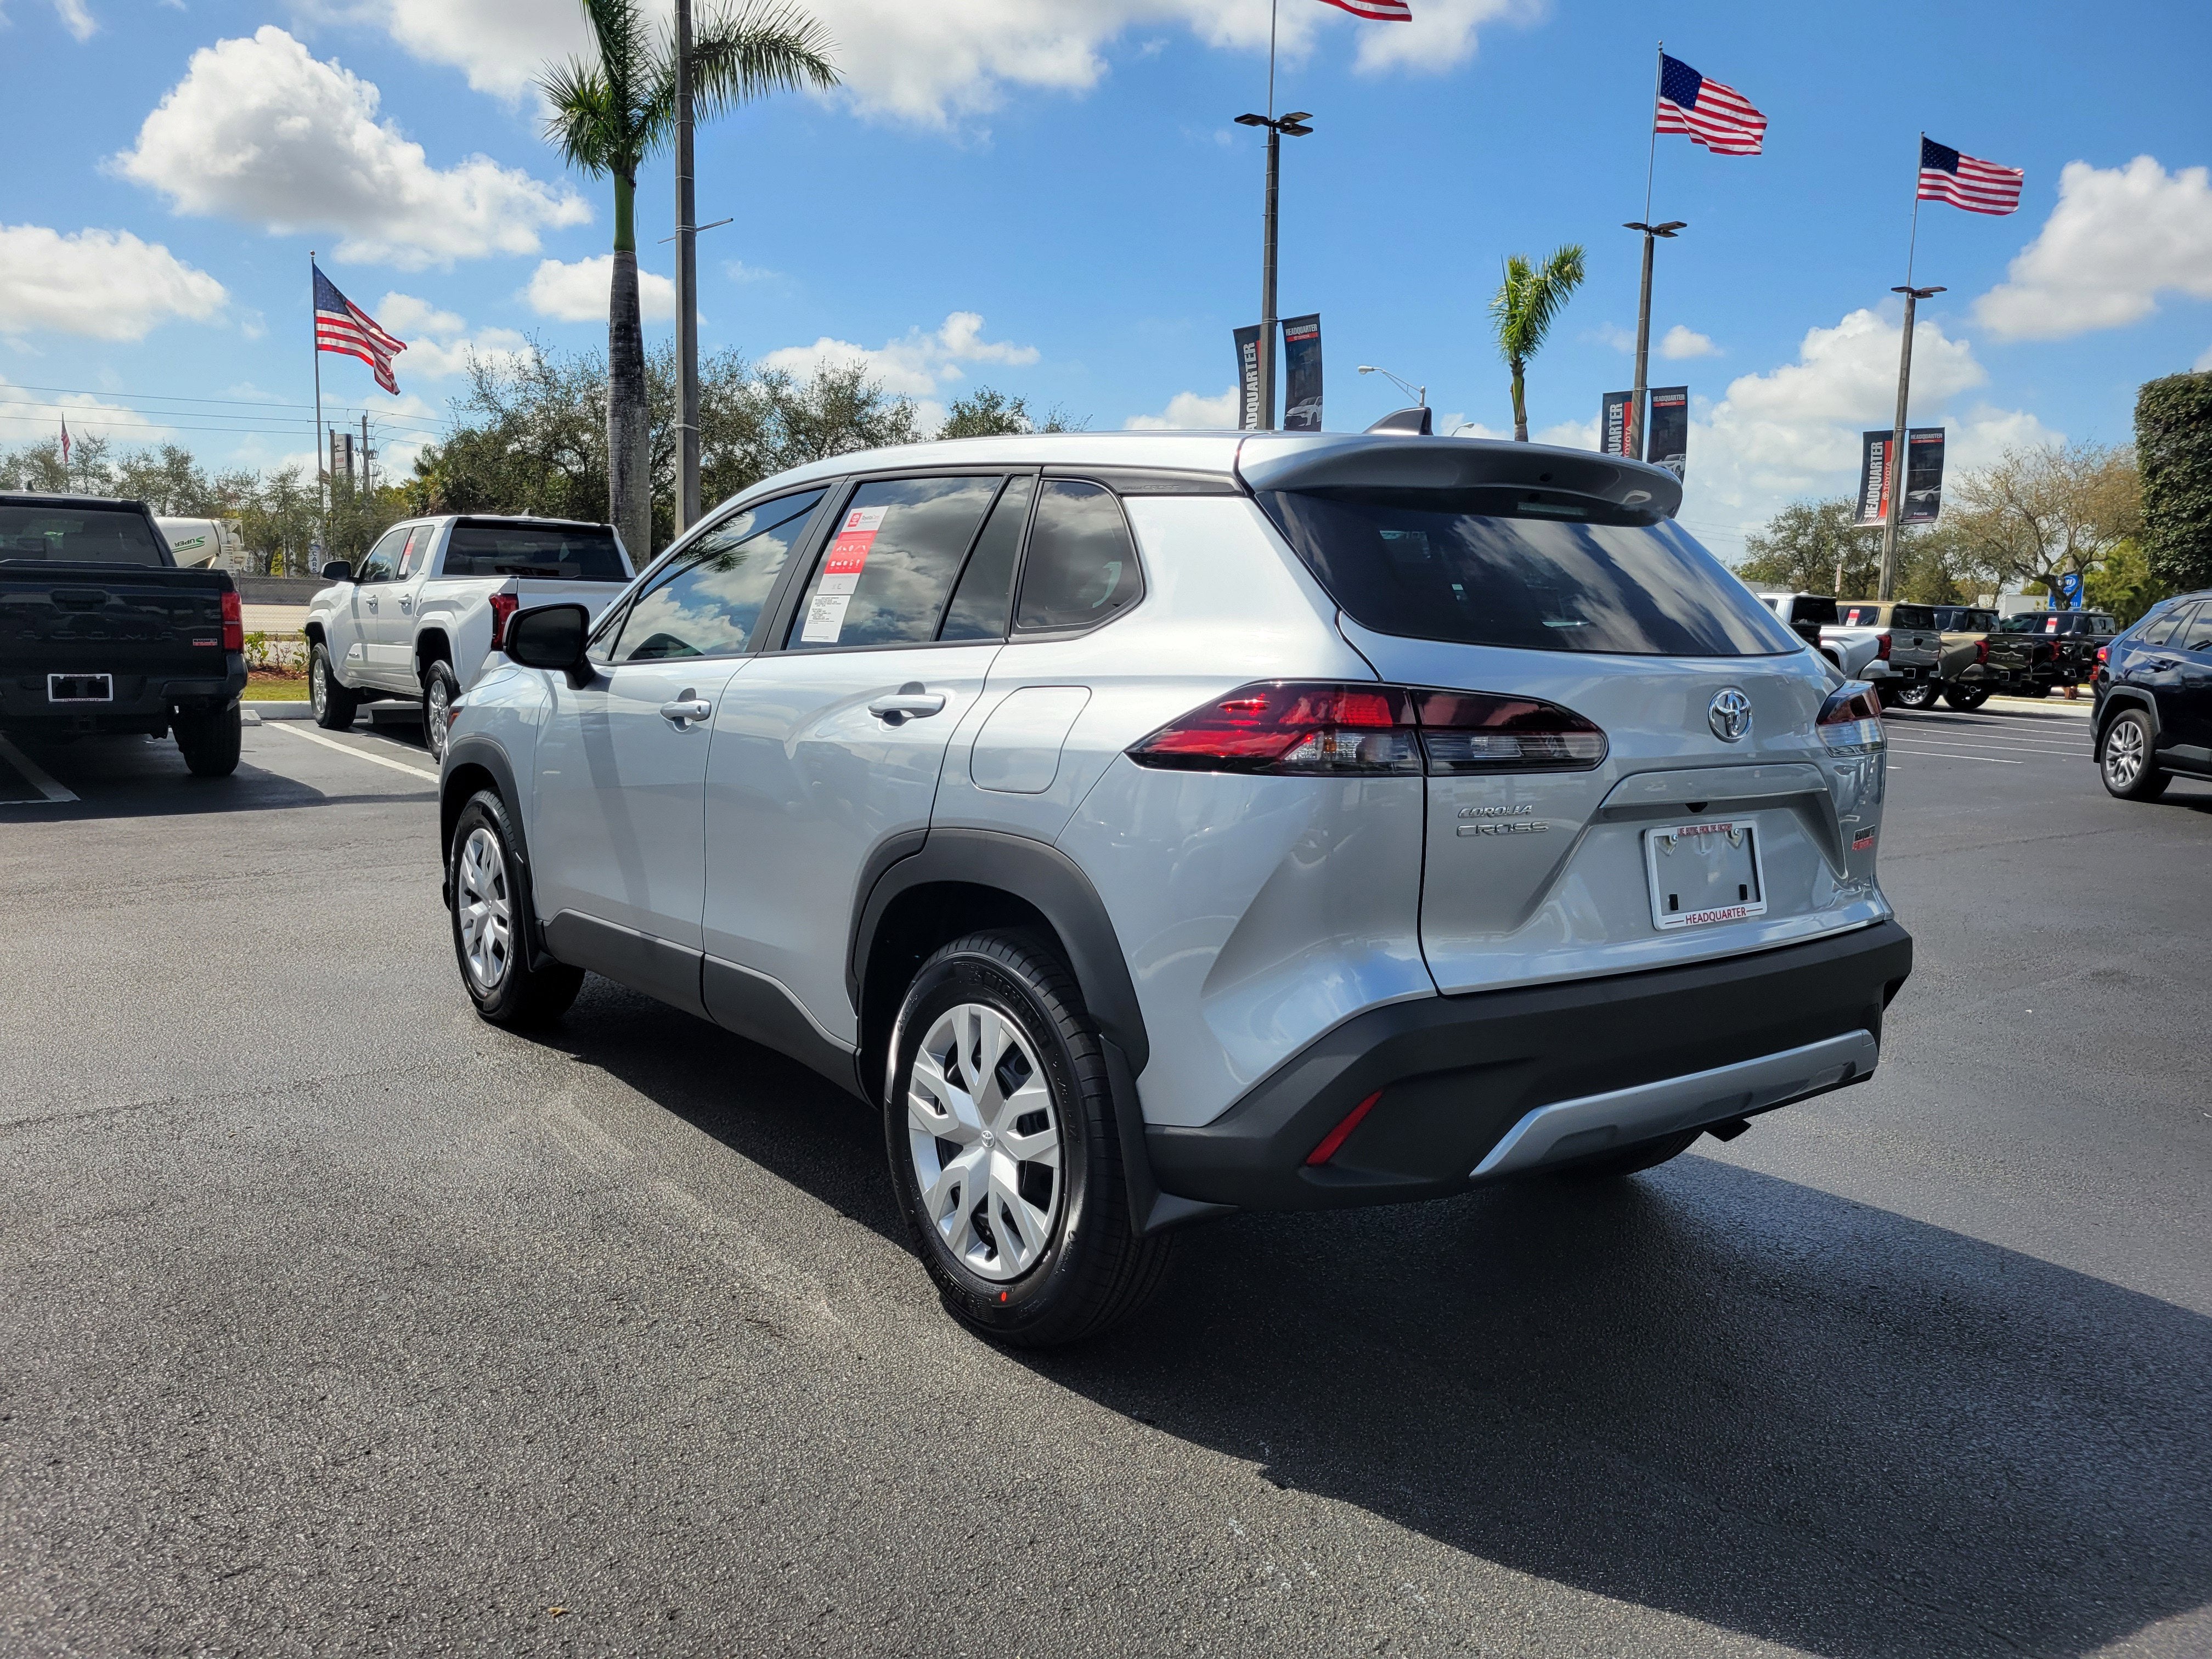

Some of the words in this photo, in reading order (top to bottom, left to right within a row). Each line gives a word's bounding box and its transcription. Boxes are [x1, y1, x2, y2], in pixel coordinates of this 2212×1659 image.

[1285, 324, 1318, 336] HEADQUARTER
[1243, 342, 1260, 430] ADQUARTER
[1608, 403, 1623, 457] QUARTER
[1864, 441, 1883, 518] HEADQUARTER
[174, 535, 206, 547] SUPER
[2, 631, 179, 640] ACOMA
[1458, 804, 1533, 818] COROLLA
[1457, 821, 1549, 837] CROSS
[1685, 907, 1747, 925] HEADQUARTER
